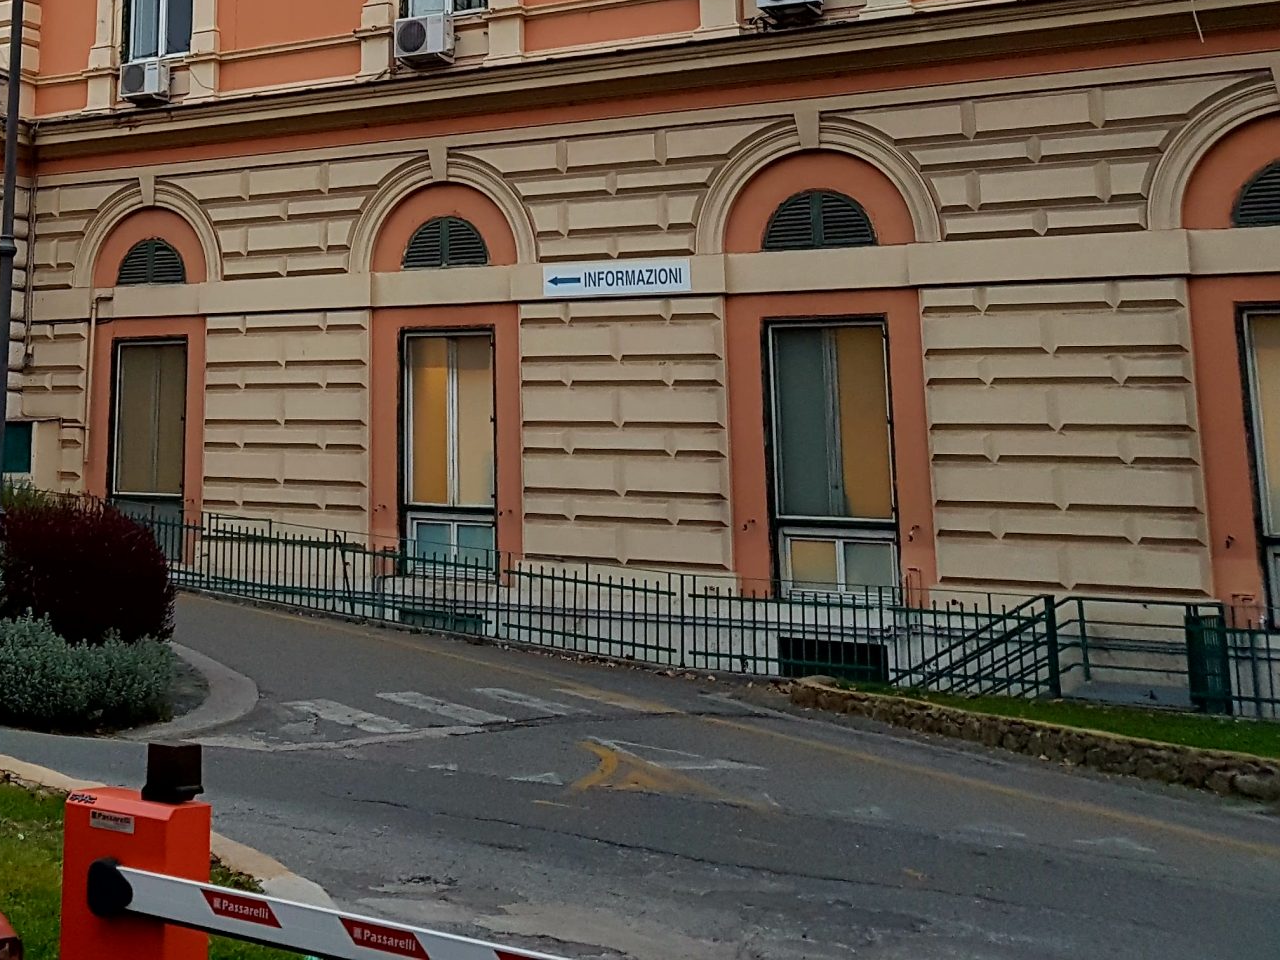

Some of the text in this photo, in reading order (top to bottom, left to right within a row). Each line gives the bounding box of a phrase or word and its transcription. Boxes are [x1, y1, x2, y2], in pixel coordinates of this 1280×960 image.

[583, 267, 683, 288] INFORMAZIONI
[221, 897, 269, 921] Passarelli
[362, 928, 417, 952] Passarelli
